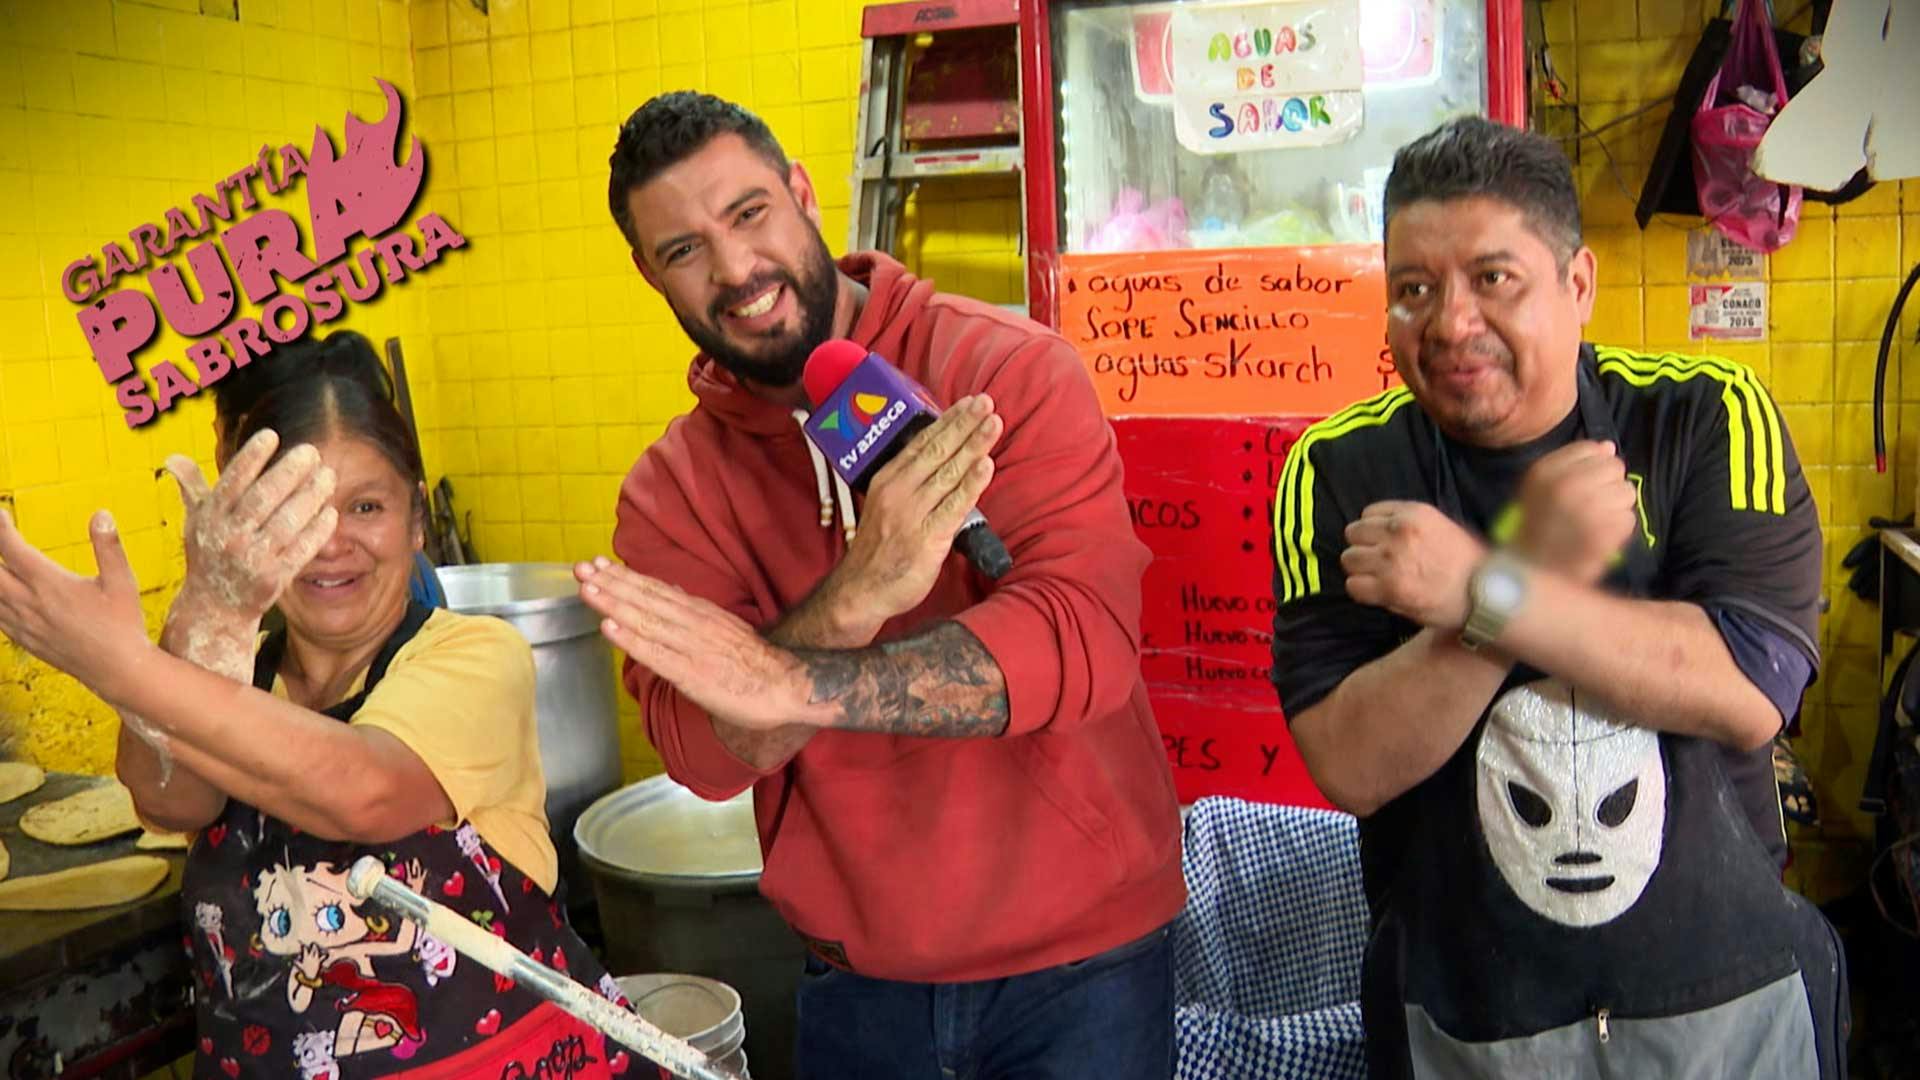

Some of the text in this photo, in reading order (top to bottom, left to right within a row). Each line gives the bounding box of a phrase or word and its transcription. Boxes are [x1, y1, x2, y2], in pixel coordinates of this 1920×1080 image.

[1208, 23, 1317, 62] AGUAS
[1236, 63, 1275, 91] DE
[1208, 95, 1331, 138] SABOR
[1088, 262, 1352, 313] aguas de sabor
[1094, 353, 1188, 402] aguas
[839, 400, 907, 470] tv azteca
